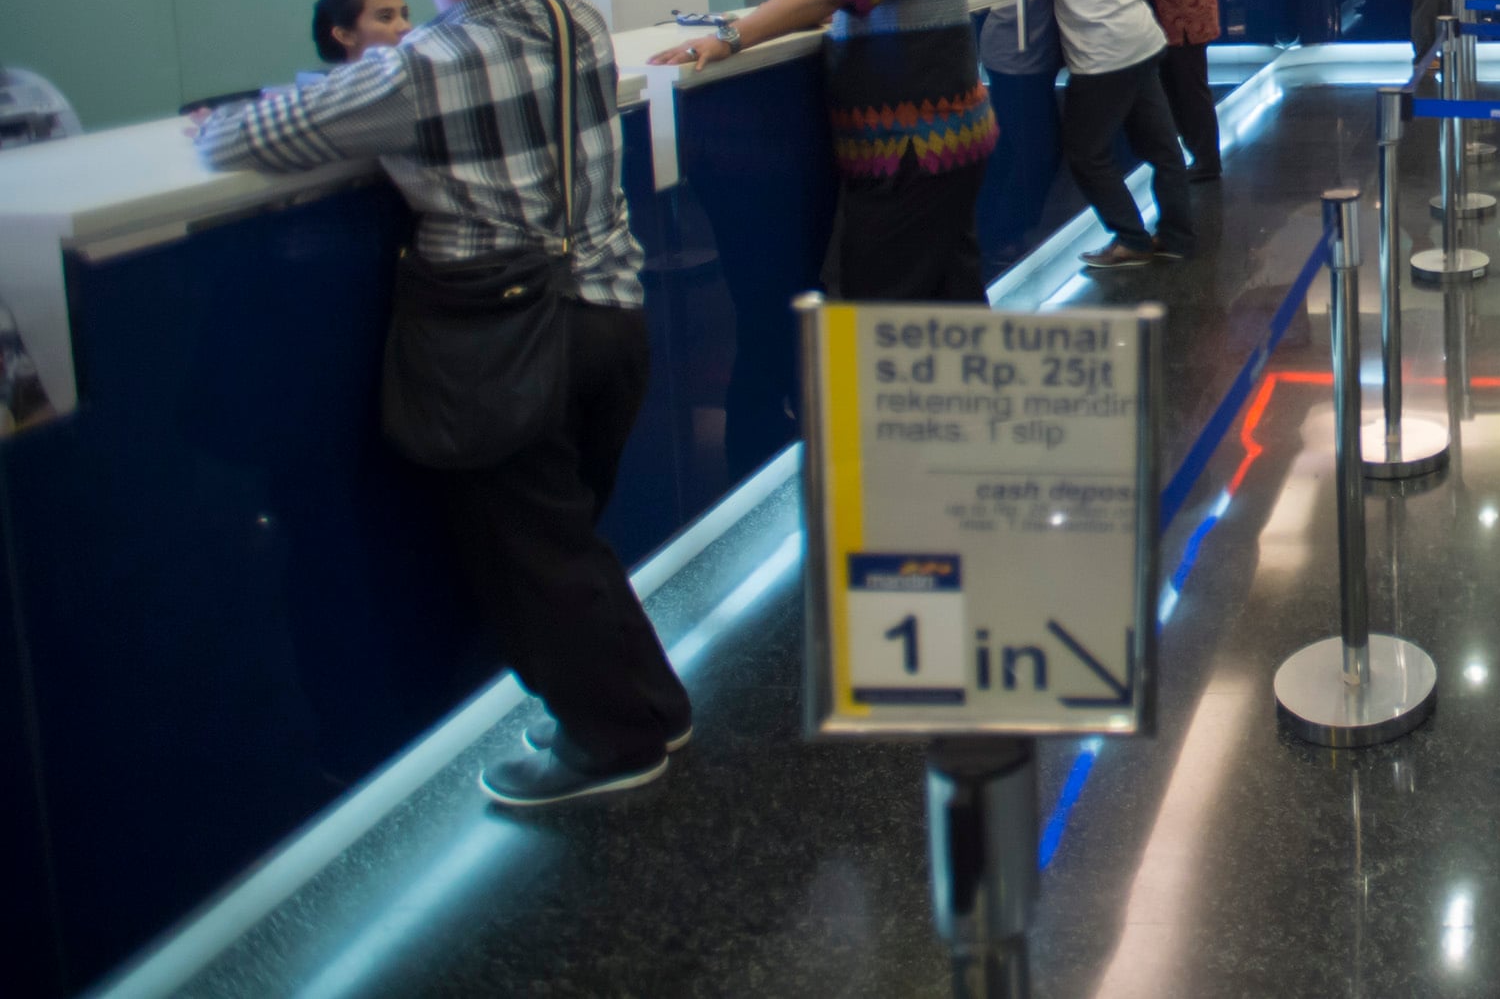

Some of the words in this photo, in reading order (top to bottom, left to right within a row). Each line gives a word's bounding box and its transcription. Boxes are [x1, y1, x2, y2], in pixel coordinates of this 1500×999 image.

[875, 319, 986, 349] setor
[1003, 320, 1111, 351] tunai
[875, 355, 936, 384] s.d
[962, 355, 1026, 390] Rp.
[1042, 357, 1114, 393] 25jt
[876, 387, 1011, 421] rekening
[1011, 421, 1066, 448] slip
[976, 480, 1039, 500] cash
[1048, 482, 1136, 506] depos
[885, 614, 919, 675] 1
[975, 628, 1048, 692] in
